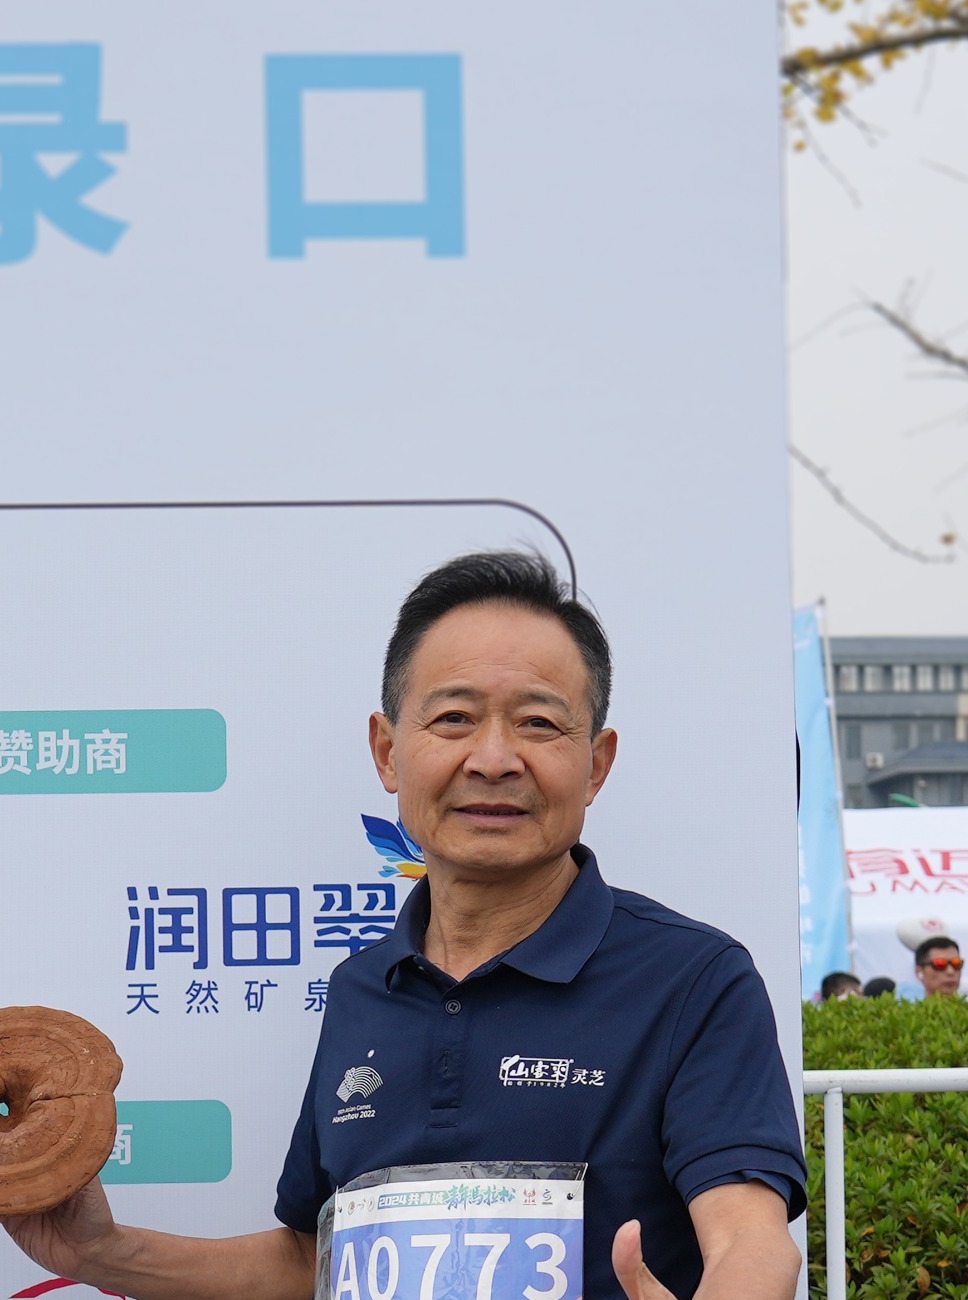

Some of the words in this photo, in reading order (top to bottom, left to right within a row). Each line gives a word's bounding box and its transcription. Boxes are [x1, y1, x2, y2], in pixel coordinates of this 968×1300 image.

[892, 879, 968, 893] MA
[126, 883, 396, 970] 润田翠
[126, 978, 329, 1015] 天然矿泉
[359, 1109, 375, 1118] 2022
